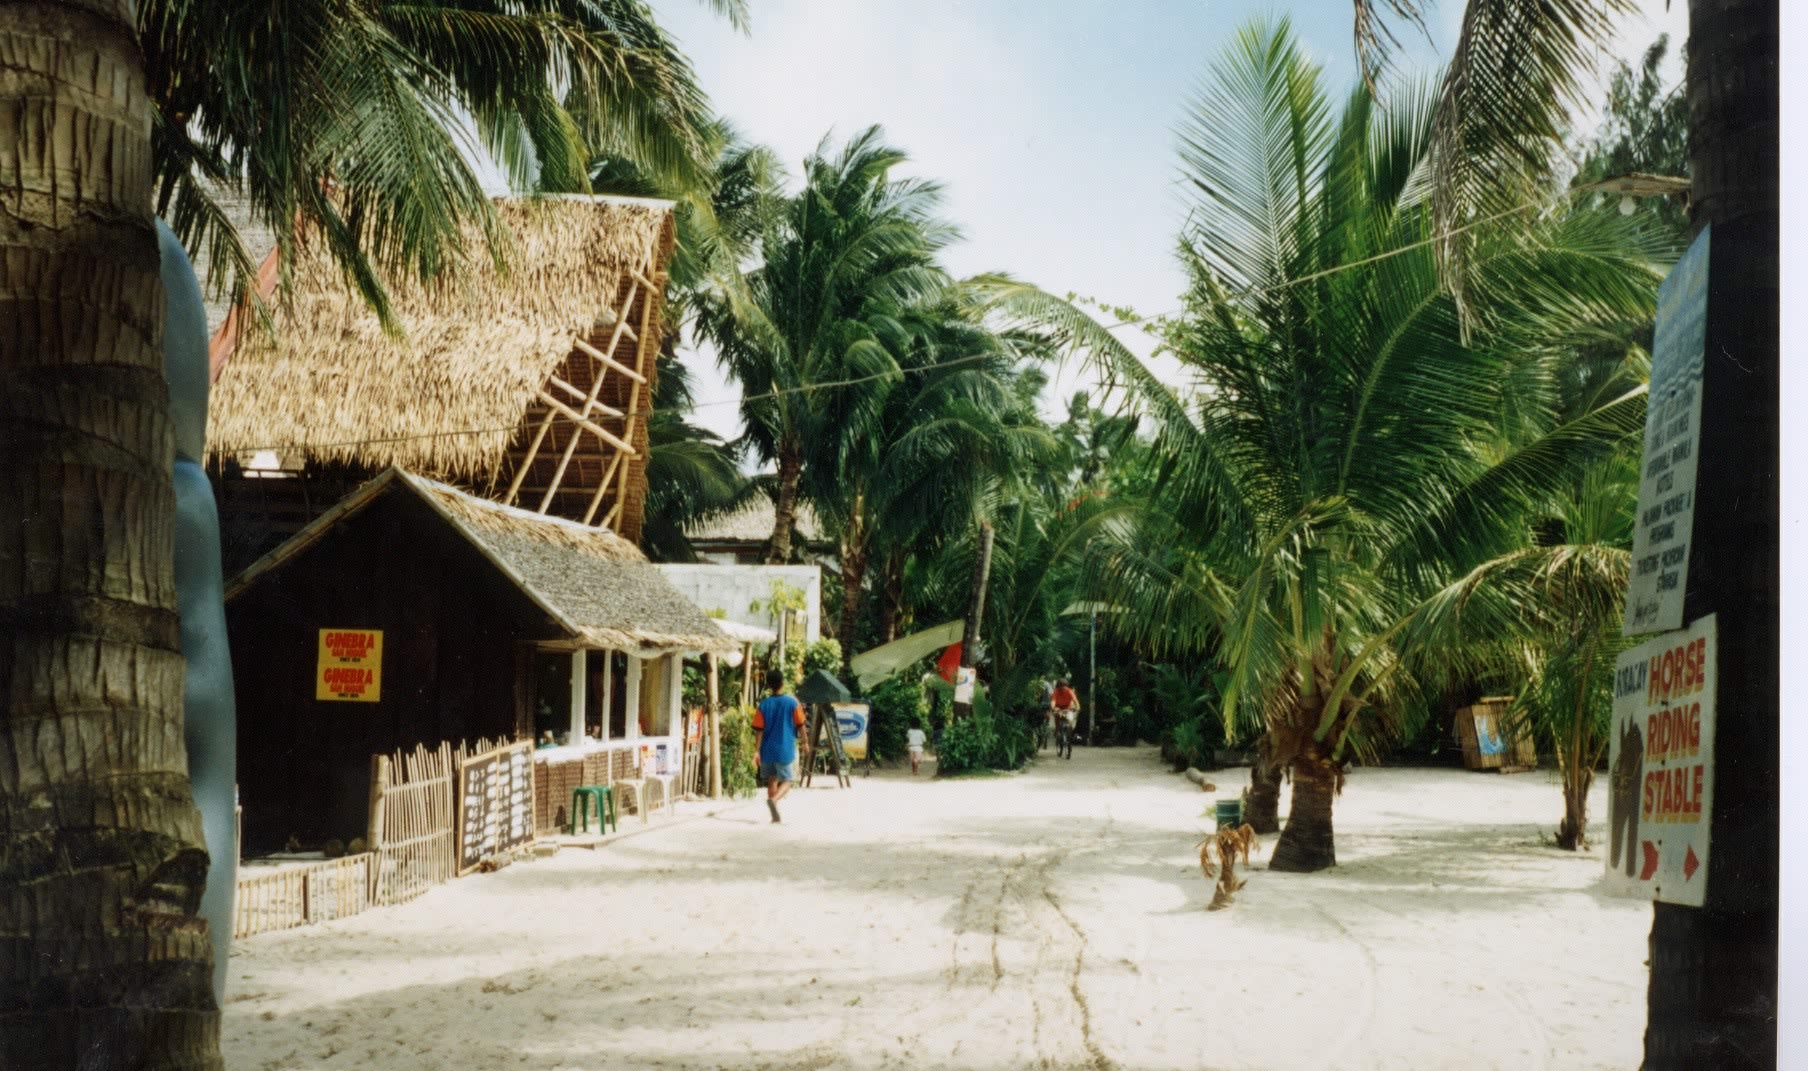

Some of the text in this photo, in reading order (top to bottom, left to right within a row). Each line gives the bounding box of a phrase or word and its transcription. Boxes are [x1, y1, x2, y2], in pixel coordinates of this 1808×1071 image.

[326, 633, 374, 649] GINEBRA
[324, 668, 372, 685] GINEBRA
[1648, 637, 1706, 705] HORSE
[1646, 703, 1700, 761] RIDING
[1643, 766, 1703, 823] STABLE
